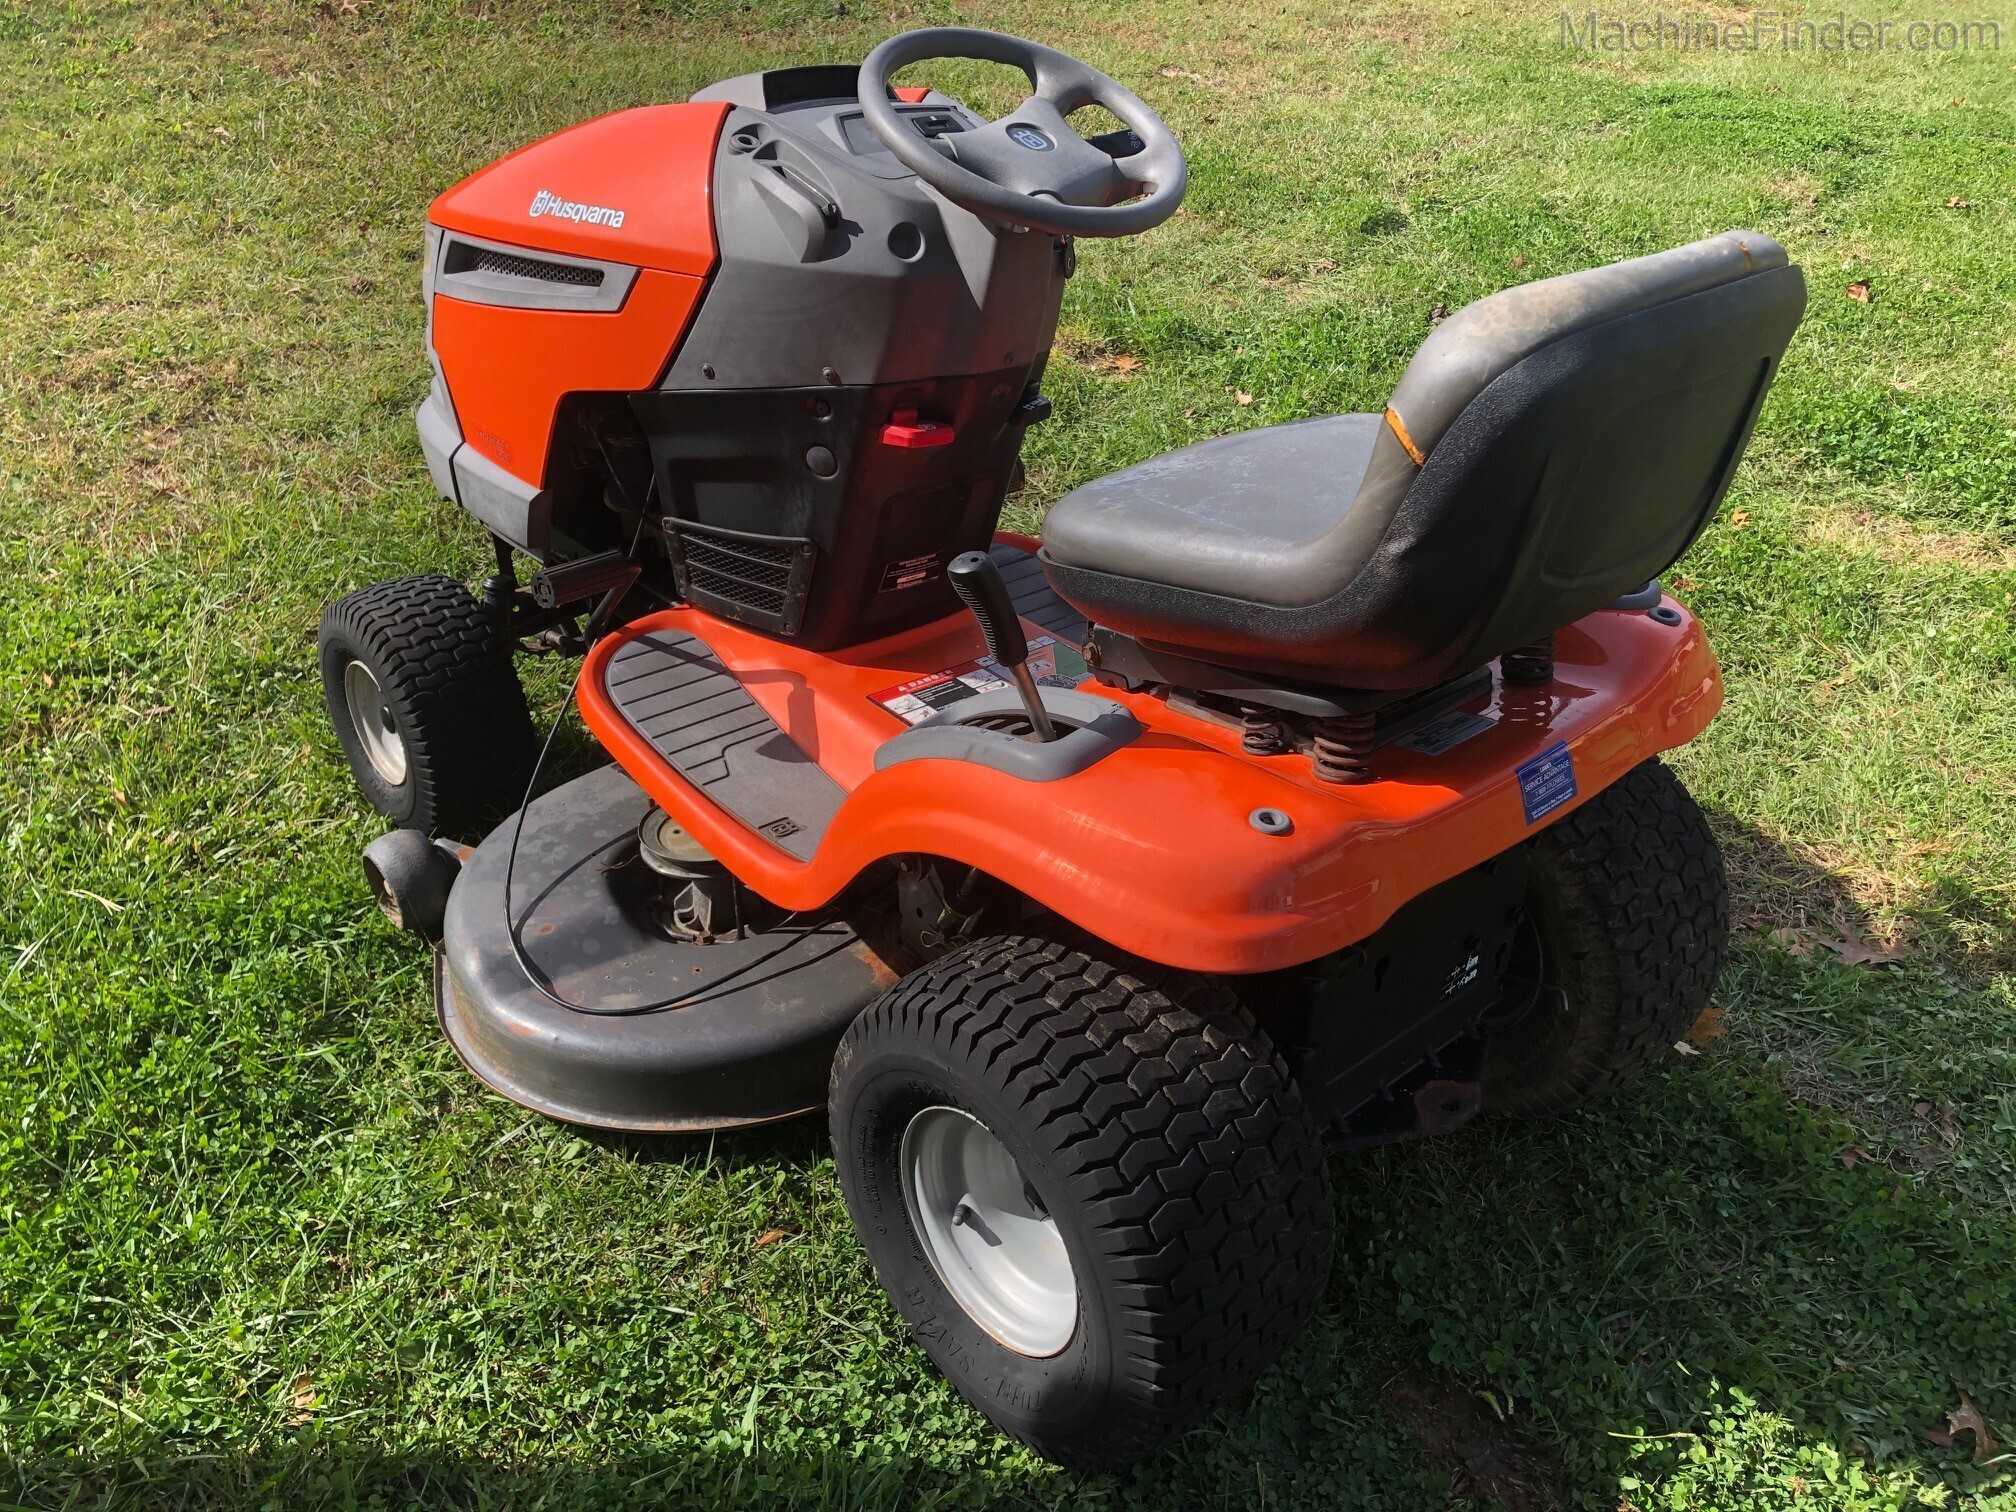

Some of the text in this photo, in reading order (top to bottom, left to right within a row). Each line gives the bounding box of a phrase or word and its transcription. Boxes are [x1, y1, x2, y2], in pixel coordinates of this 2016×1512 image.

[544, 196, 625, 228] Husqvarna
[908, 669, 954, 687] DANGER
[1524, 776, 1543, 793] SERVICE
[1543, 760, 1570, 782] ADVANTAGE
